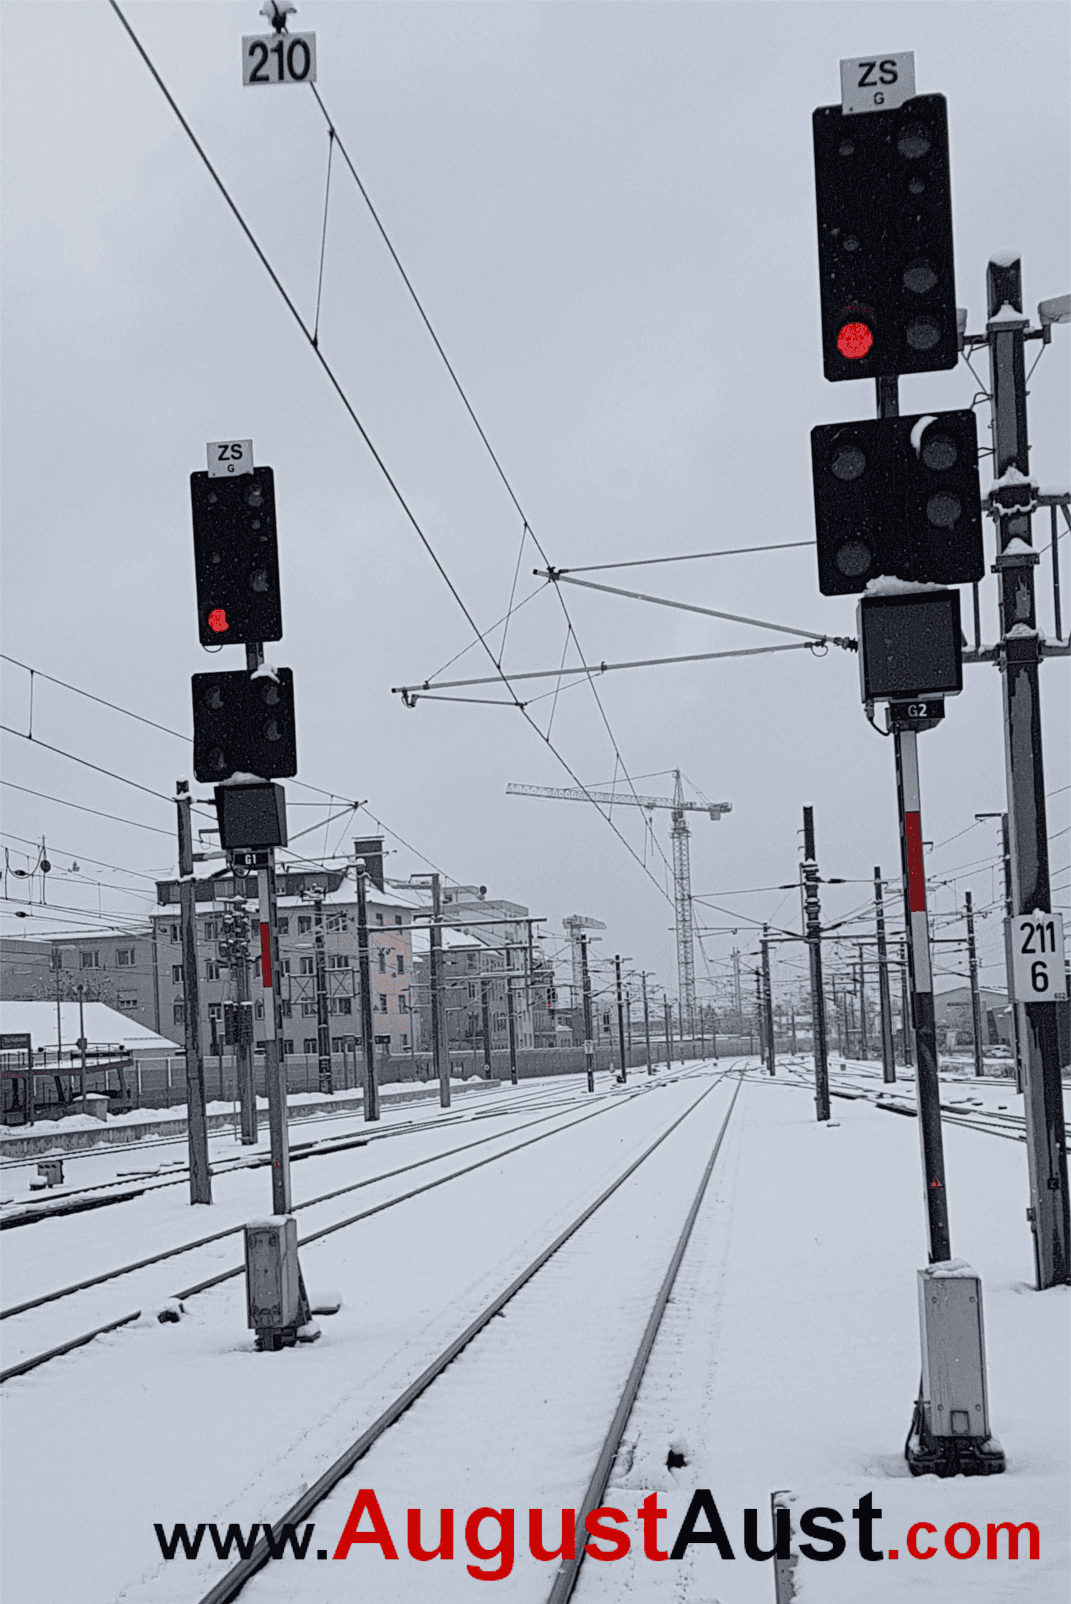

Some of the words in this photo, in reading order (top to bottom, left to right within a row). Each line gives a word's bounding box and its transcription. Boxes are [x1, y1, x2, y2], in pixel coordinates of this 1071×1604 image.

[248, 38, 311, 83] 210
[857, 59, 899, 88] ZS
[873, 91, 885, 105] G
[217, 443, 243, 461] ZS
[227, 463, 235, 473] G
[907, 703, 928, 718] G2
[244, 853, 257, 865] G1
[1020, 921, 1056, 954] 211
[1031, 960, 1049, 993] 6
